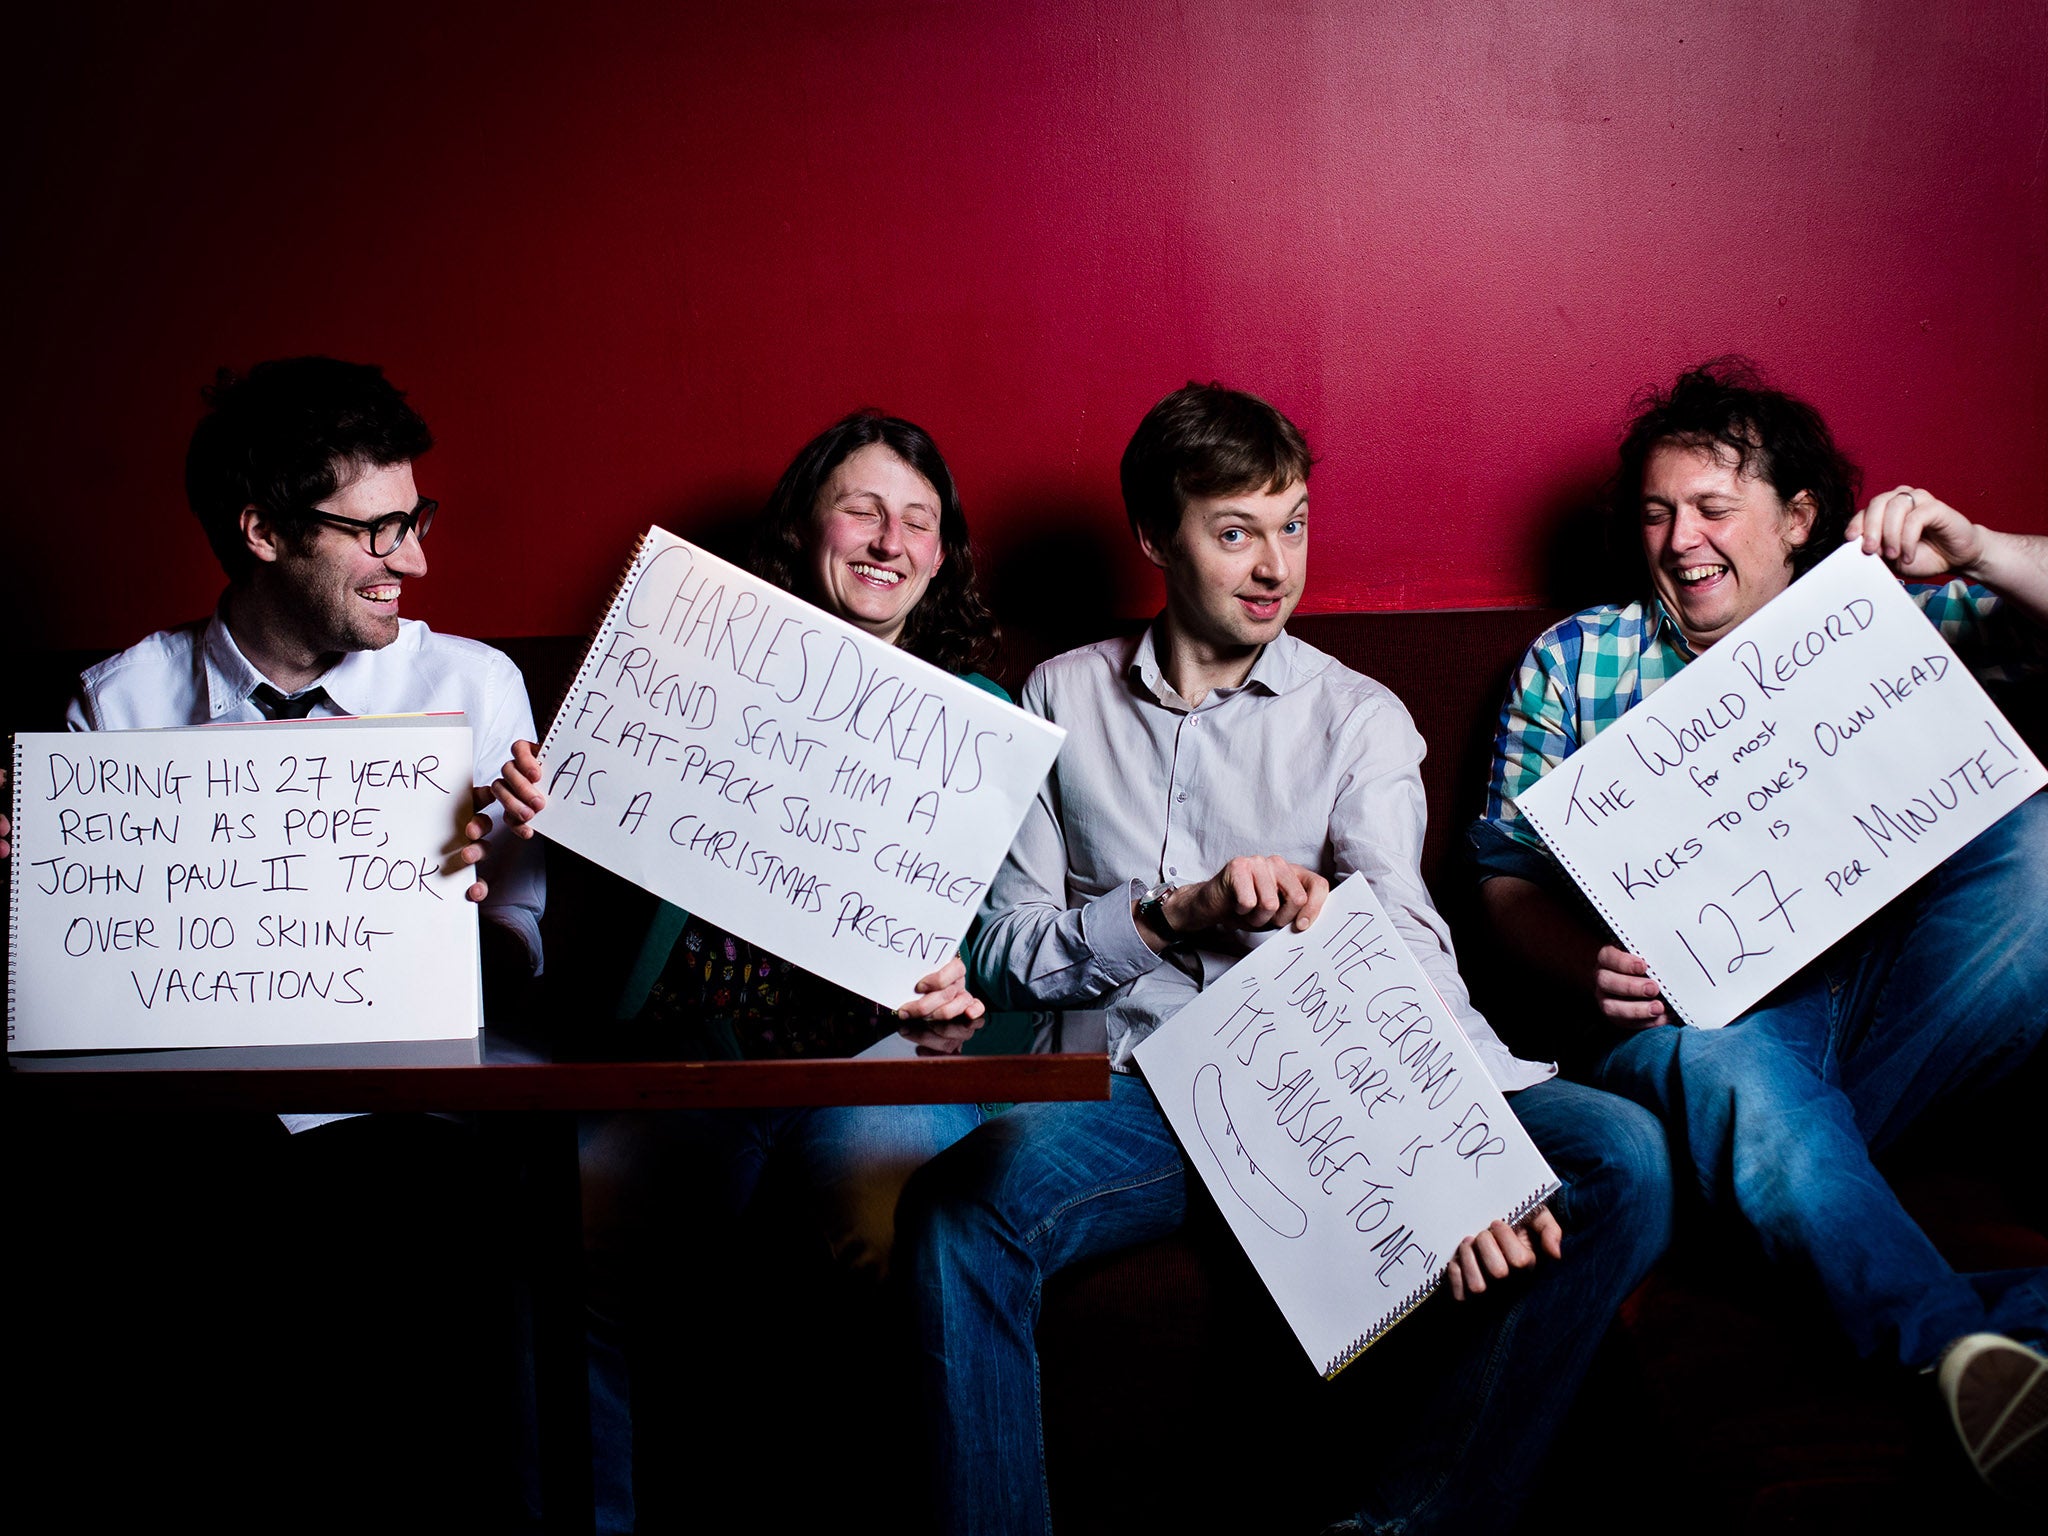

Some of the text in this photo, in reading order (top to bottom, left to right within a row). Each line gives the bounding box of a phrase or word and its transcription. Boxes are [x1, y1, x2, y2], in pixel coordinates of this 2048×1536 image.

[626, 545, 821, 703] CHARLES
[1564, 764, 1635, 827] THE
[1732, 598, 1875, 700] RECORD
[45, 753, 451, 804] DURING HIS 27 YEAR
[58, 807, 390, 847] REIGN AS POPE,
[573, 691, 986, 907] FLAT-PACK SWISS CHALET
[594, 632, 939, 835] FRIEND SENT HIM A
[1611, 653, 1949, 900] KICKS TO ONE'S OWN HEAD
[1768, 820, 1790, 840] IS
[31, 854, 444, 902] JOHN PAUL II TOOK
[64, 914, 394, 957] OVER 100 SKIING
[548, 751, 957, 966] AS A CHRISTMAS PRESENT
[1676, 720, 2029, 987] 127 PER MINUTE!
[131, 966, 374, 1010] VACATIONS.
[1287, 971, 1352, 1046] DON'T
[1397, 1134, 1434, 1177] IS
[1322, 911, 1506, 1179] THE GERMAN FOR
[1256, 1050, 1371, 1195] SAUSAGE
[1346, 1179, 1394, 1233] TO
